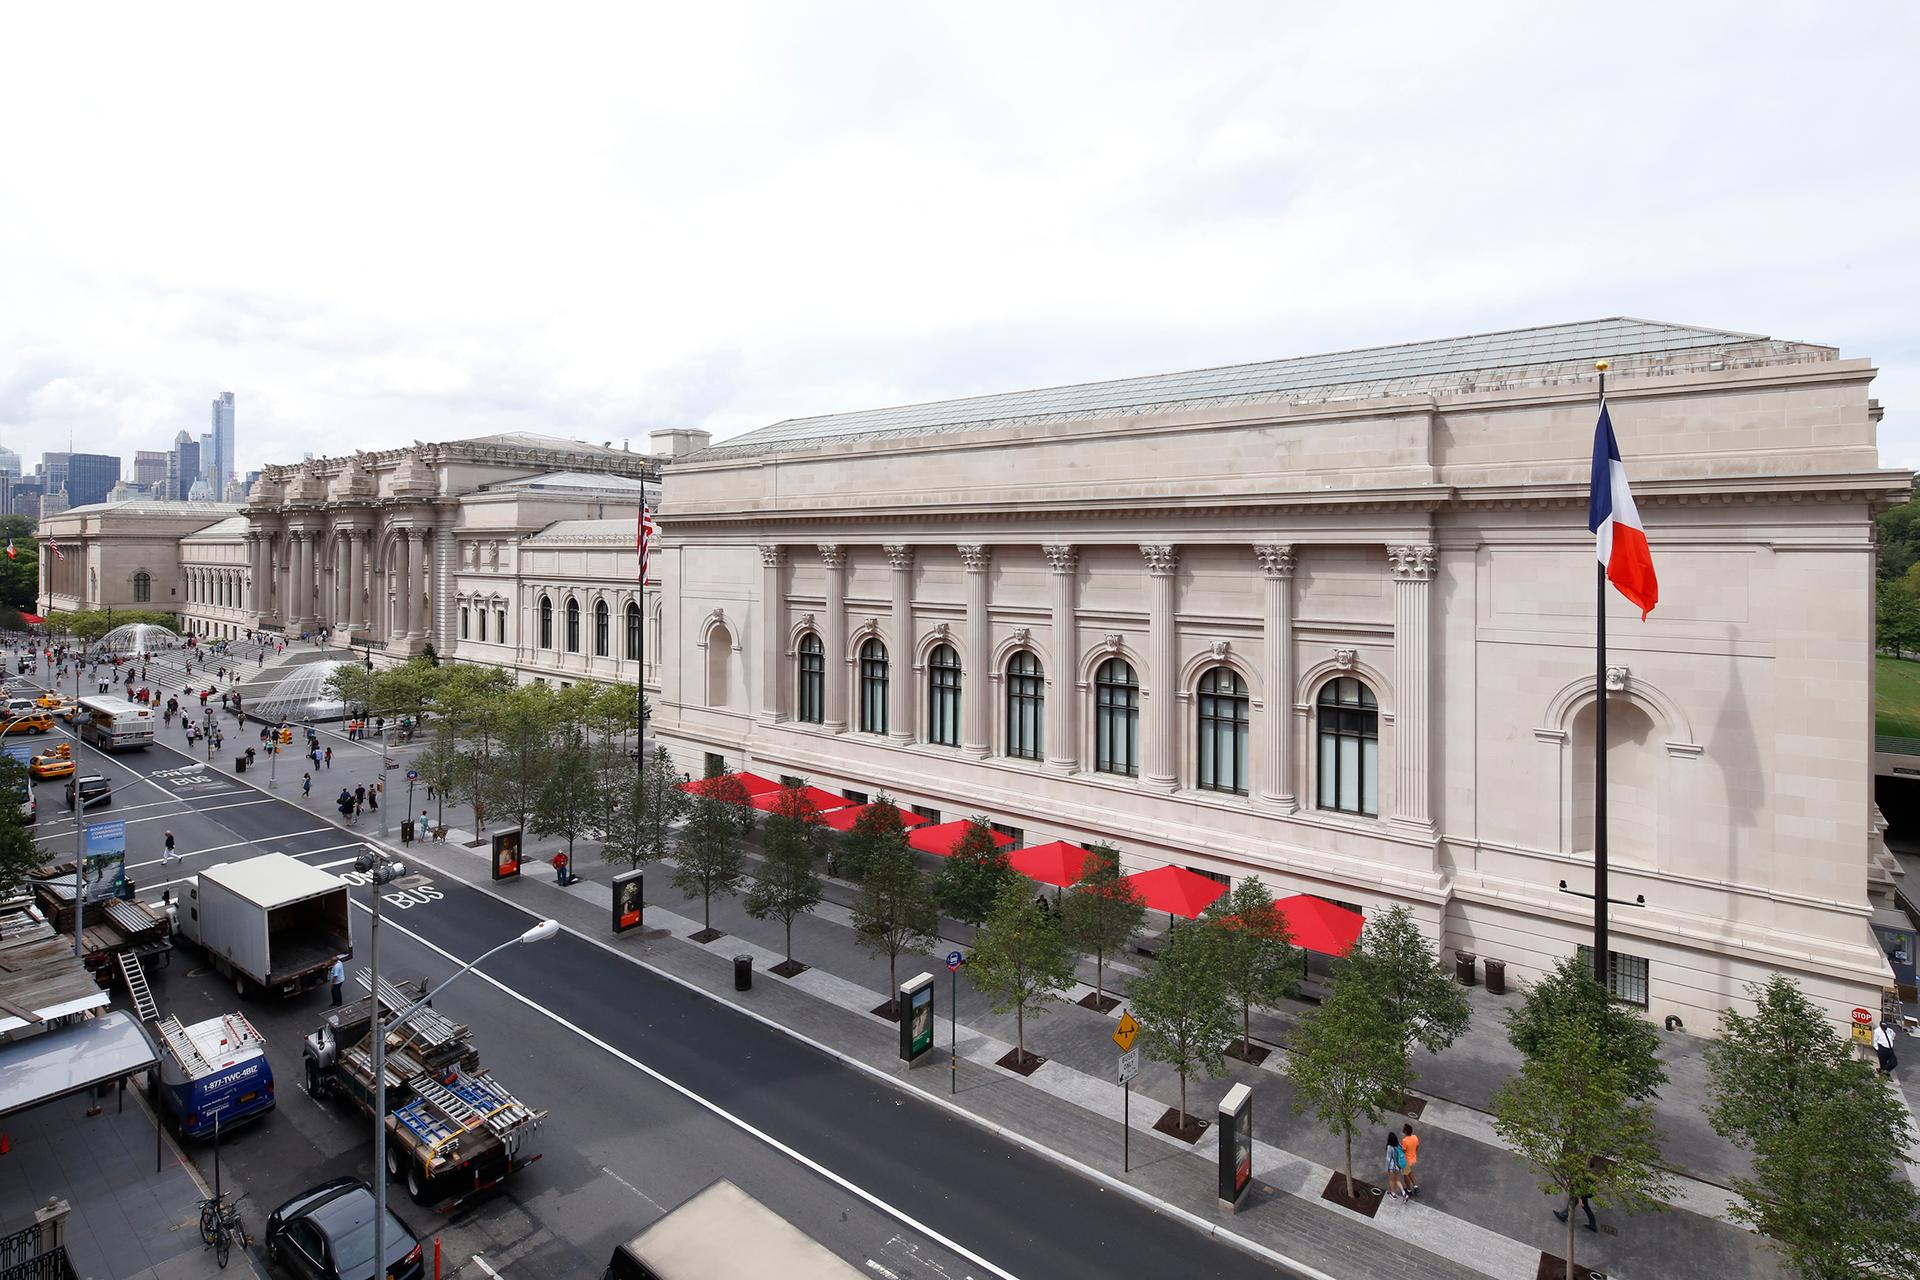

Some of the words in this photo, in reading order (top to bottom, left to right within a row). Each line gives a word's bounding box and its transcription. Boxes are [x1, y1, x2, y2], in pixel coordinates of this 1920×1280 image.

[170, 776, 212, 786] BUS
[340, 868, 375, 886] ON
[381, 886, 444, 909] BUS
[1852, 1011, 1871, 1020] STOP
[203, 1065, 258, 1092] 1-877-TWC-4BIZ
